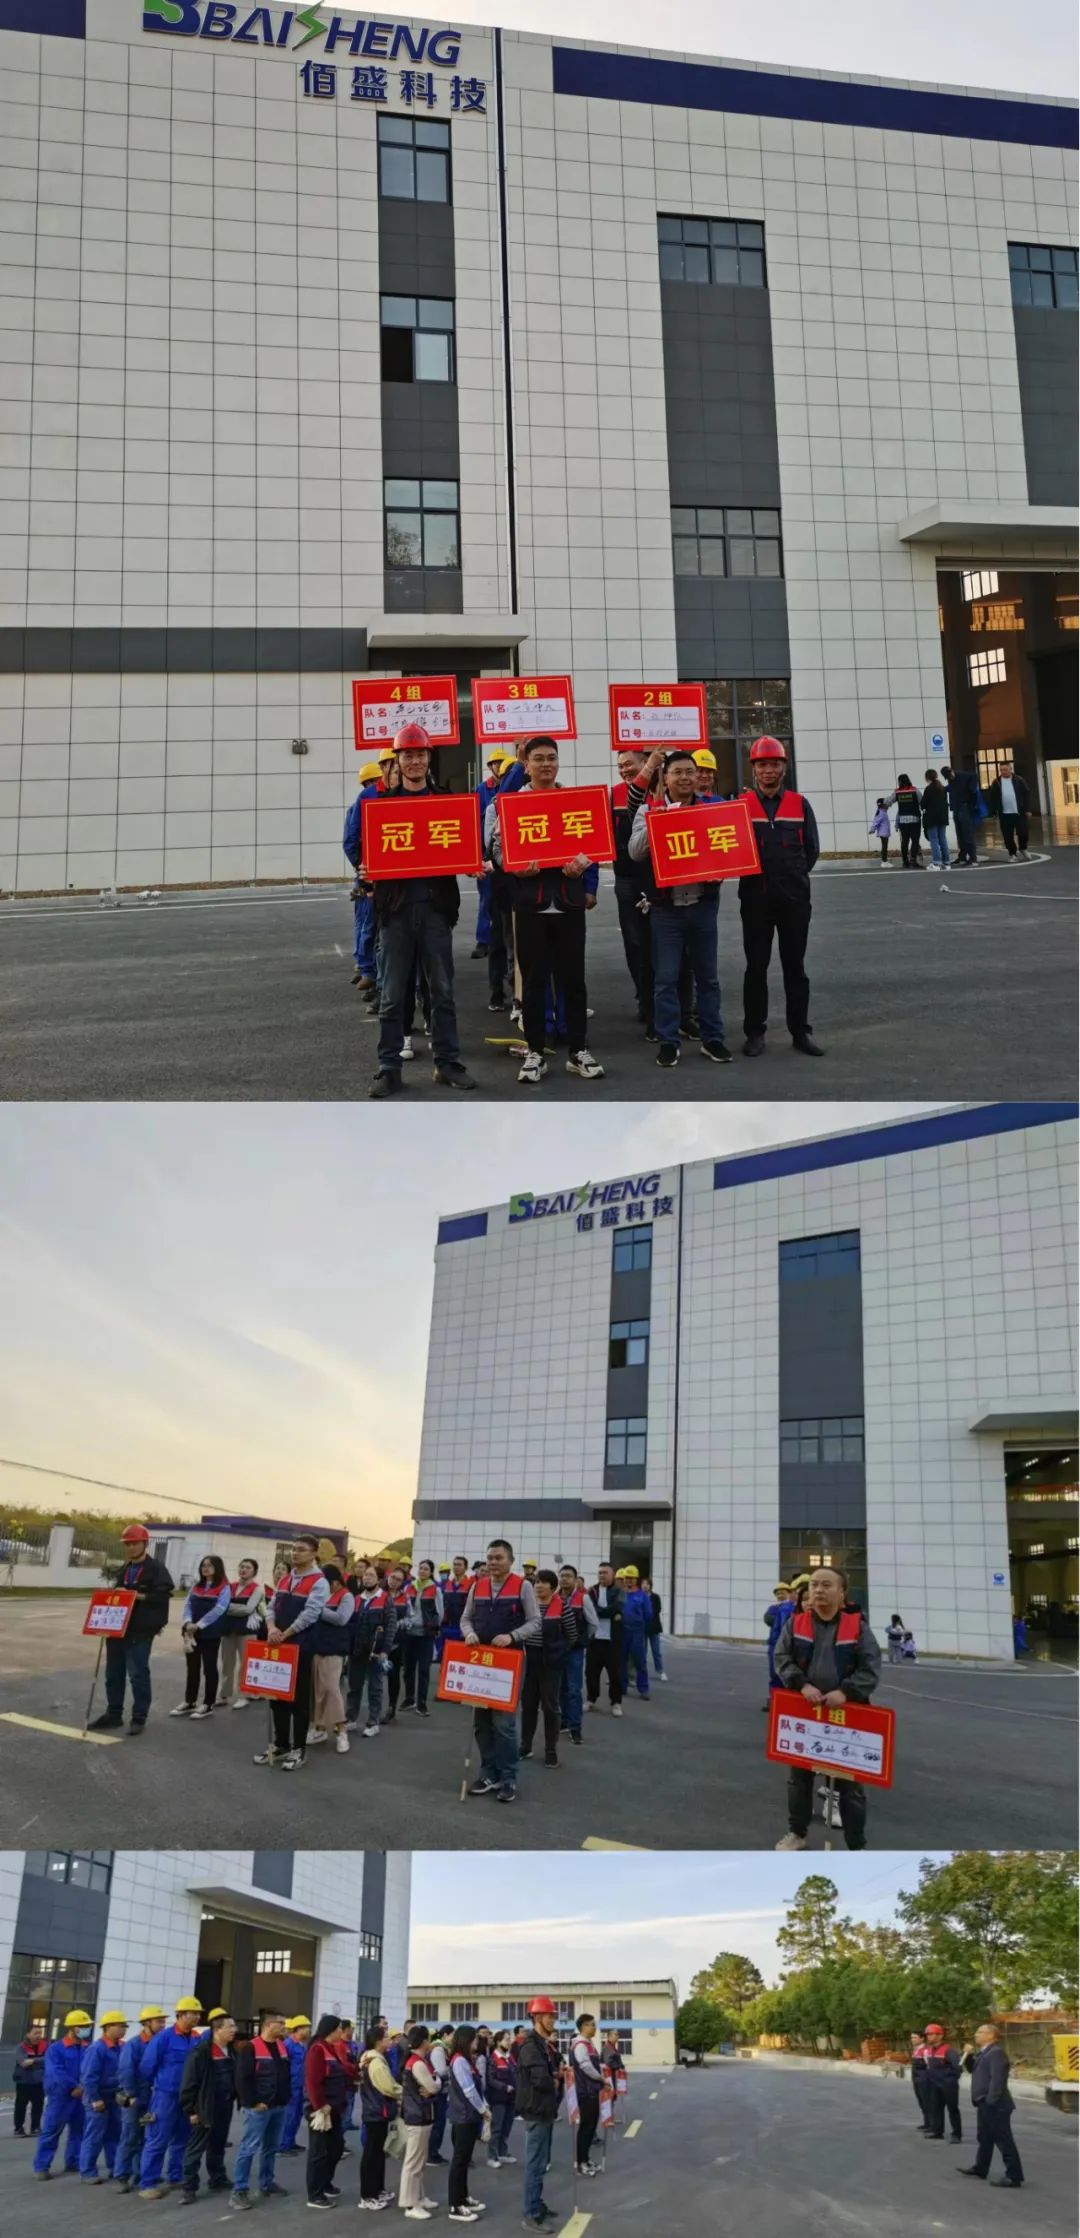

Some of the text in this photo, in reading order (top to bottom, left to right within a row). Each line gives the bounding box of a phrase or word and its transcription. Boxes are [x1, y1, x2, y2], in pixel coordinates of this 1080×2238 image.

[300, 59, 487, 114] 佰盛科技
[381, 819, 462, 853] 冠军
[517, 810, 594, 845] 冠军
[666, 824, 740, 861] 亚军
[576, 1195, 675, 1233] 佰盛科技
